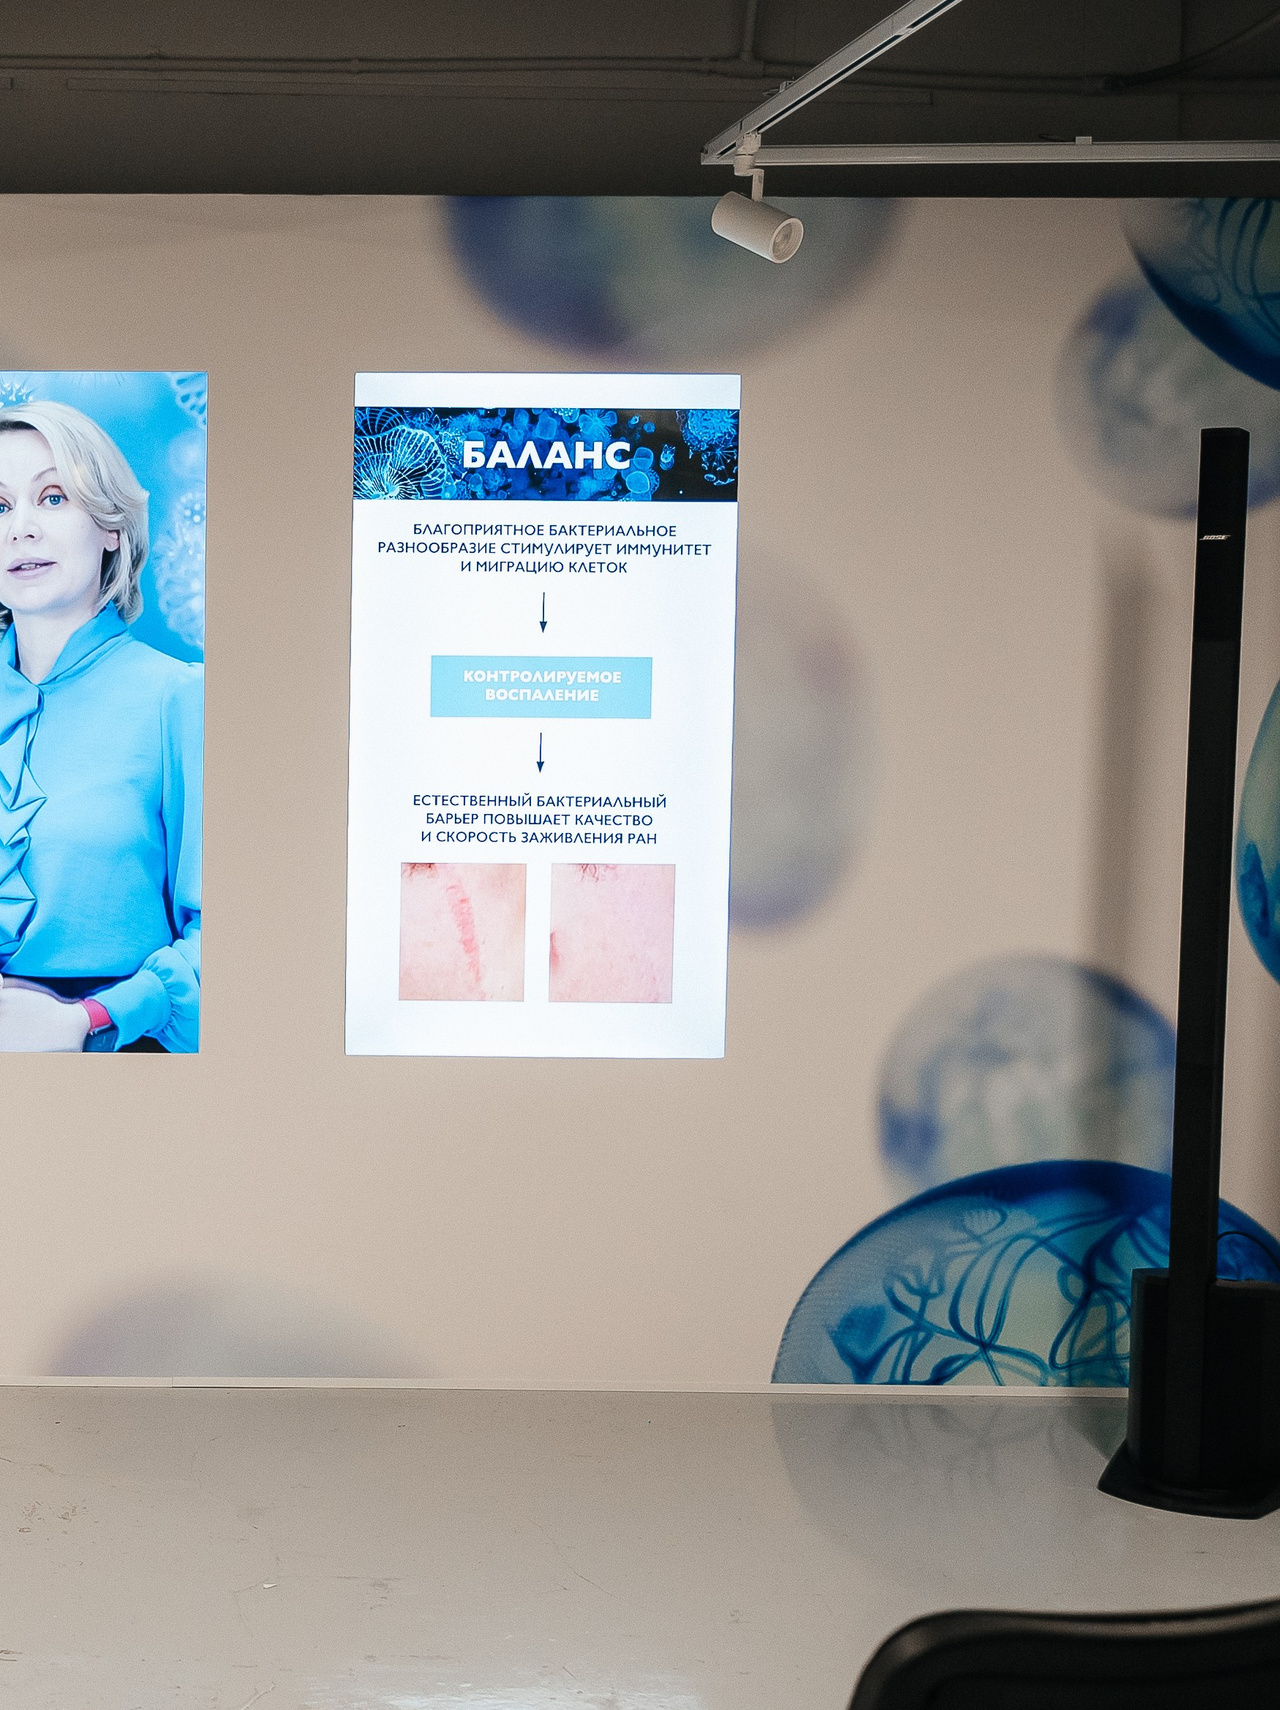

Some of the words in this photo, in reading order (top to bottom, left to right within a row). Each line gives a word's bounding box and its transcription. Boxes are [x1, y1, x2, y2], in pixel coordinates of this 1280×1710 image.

[463, 440, 631, 470] БАЛАНС
[413, 523, 545, 537] БЛАГОПРИЯТНОЕ
[549, 524, 677, 537] БАКТЕРИАЛЬНОЕ
[377, 541, 496, 555] РАЗНООБРАЗИЕ
[500, 542, 612, 556] СТИМУЛИРУЕТ
[616, 542, 712, 556] ИММУНИТЕТ
[460, 560, 472, 573] И
[476, 560, 564, 575] МИГРАЦИЮ
[568, 561, 628, 574] КЛЕТОК
[463, 669, 622, 684] КОНТРОЛИРУЕМОЕ
[485, 688, 599, 702] ВОСПАЛЕНИЕ
[413, 792, 533, 807] ЕСТЕСТВЕННЫЙ
[536, 793, 667, 809] БАКТЕРИАЛЬНЫЙ
[426, 812, 479, 825] БАРЬЕР
[483, 813, 570, 826] ПОВЫШАЕТ
[575, 813, 653, 827] КАЧЕСТВО
[421, 831, 432, 843] И
[436, 831, 517, 844] СКОРОСТЬ
[521, 831, 623, 845] ЗАЖИВЛЕНИЯ
[627, 832, 657, 845] РАН
